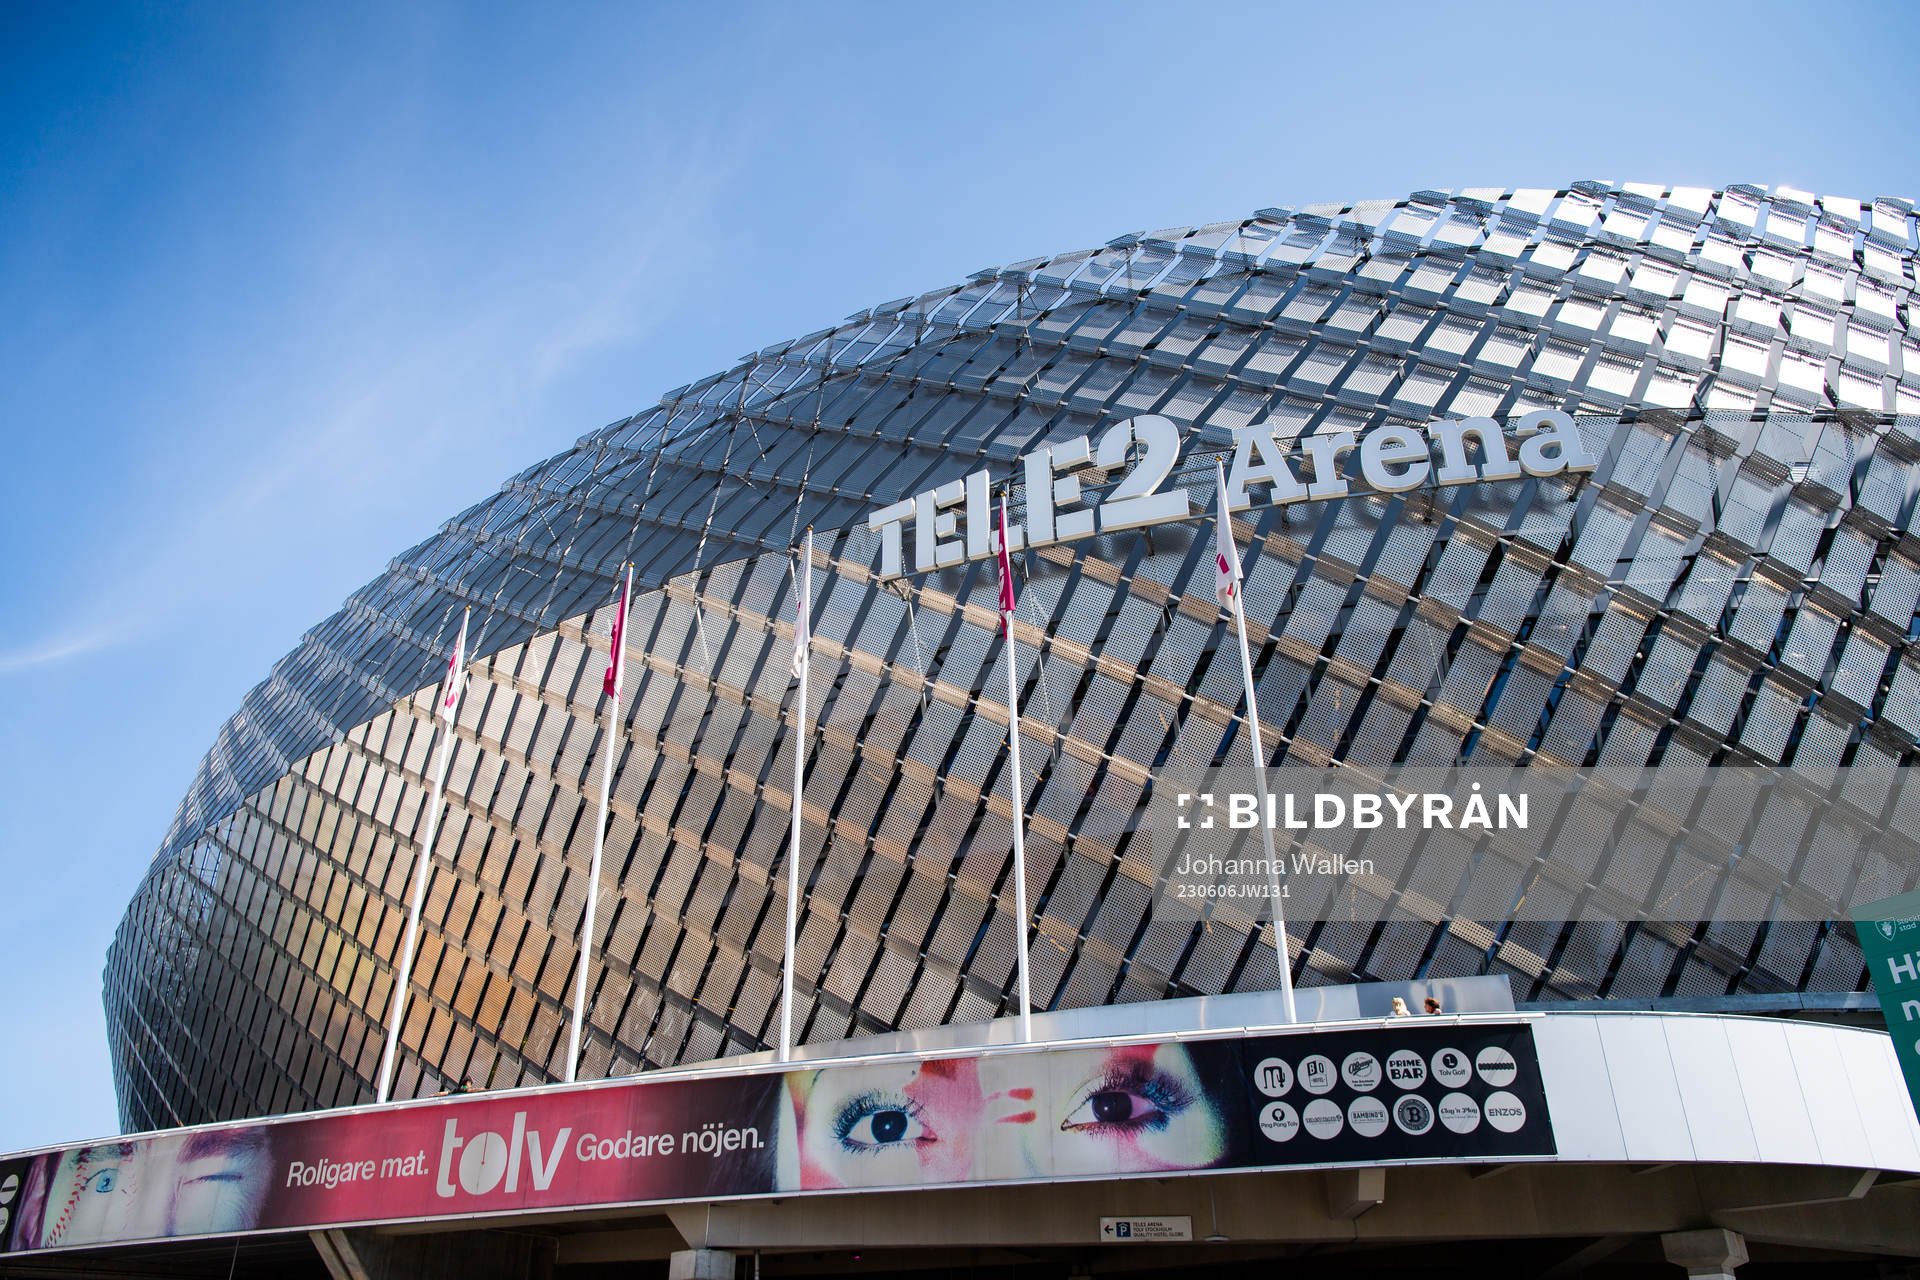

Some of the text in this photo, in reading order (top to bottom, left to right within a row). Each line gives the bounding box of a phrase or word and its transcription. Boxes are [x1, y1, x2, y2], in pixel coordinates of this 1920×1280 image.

[868, 413, 1190, 581] TELE2
[1228, 406, 1598, 513] Arena
[1887, 951, 1920, 985] H
[1389, 1059, 1422, 1067] PRIME
[1390, 1068, 1424, 1080] BAR
[1488, 1108, 1523, 1117] ENZOS
[436, 1111, 573, 1198] tolv
[576, 1122, 765, 1162] Godare nöjen.
[286, 1150, 429, 1190] Roligare mat.
